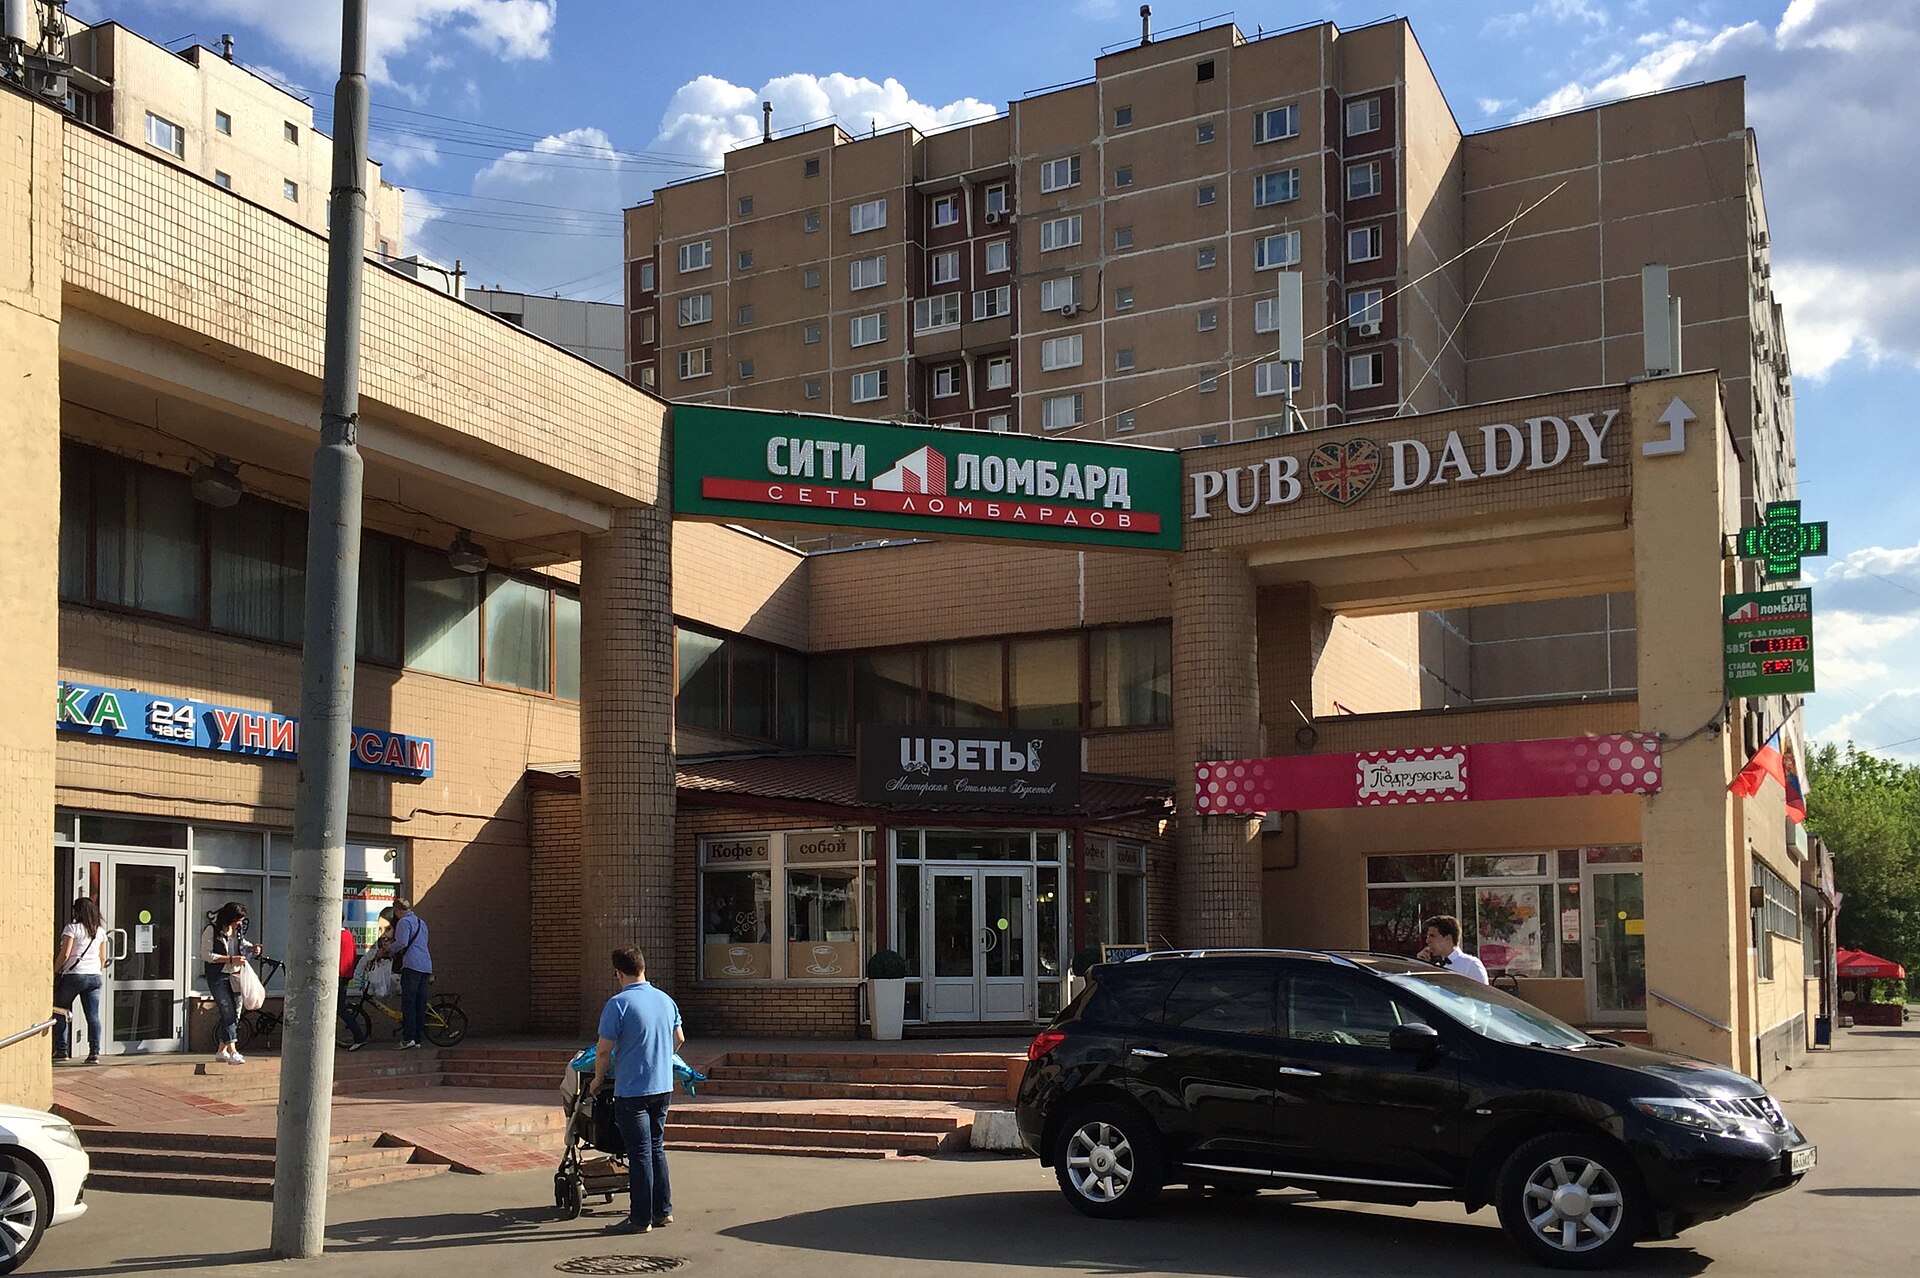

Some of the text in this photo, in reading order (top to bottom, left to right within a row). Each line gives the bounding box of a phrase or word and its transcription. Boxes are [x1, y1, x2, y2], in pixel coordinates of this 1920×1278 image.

[766, 436, 1131, 509] СИТИ ЛОМБАРД
[1190, 409, 1620, 519] PUB DADDY
[768, 485, 1131, 527] СЕТЬ ЛОМБАРДОВ
[1781, 594, 1807, 604] СИТИ
[1760, 603, 1808, 615] ЛОМБАРД
[1728, 662, 1757, 670] СТАВКА
[1736, 670, 1757, 678] ДЕНЬ
[152, 700, 196, 728] 24
[152, 724, 195, 740] часа
[901, 737, 1043, 776] ЦВЕТЫ
[1370, 765, 1454, 788] Подружка
[885, 776, 1057, 799] Мастерская Стильных Букетов
[711, 843, 765, 859] Кофе с
[800, 839, 847, 854] собой
